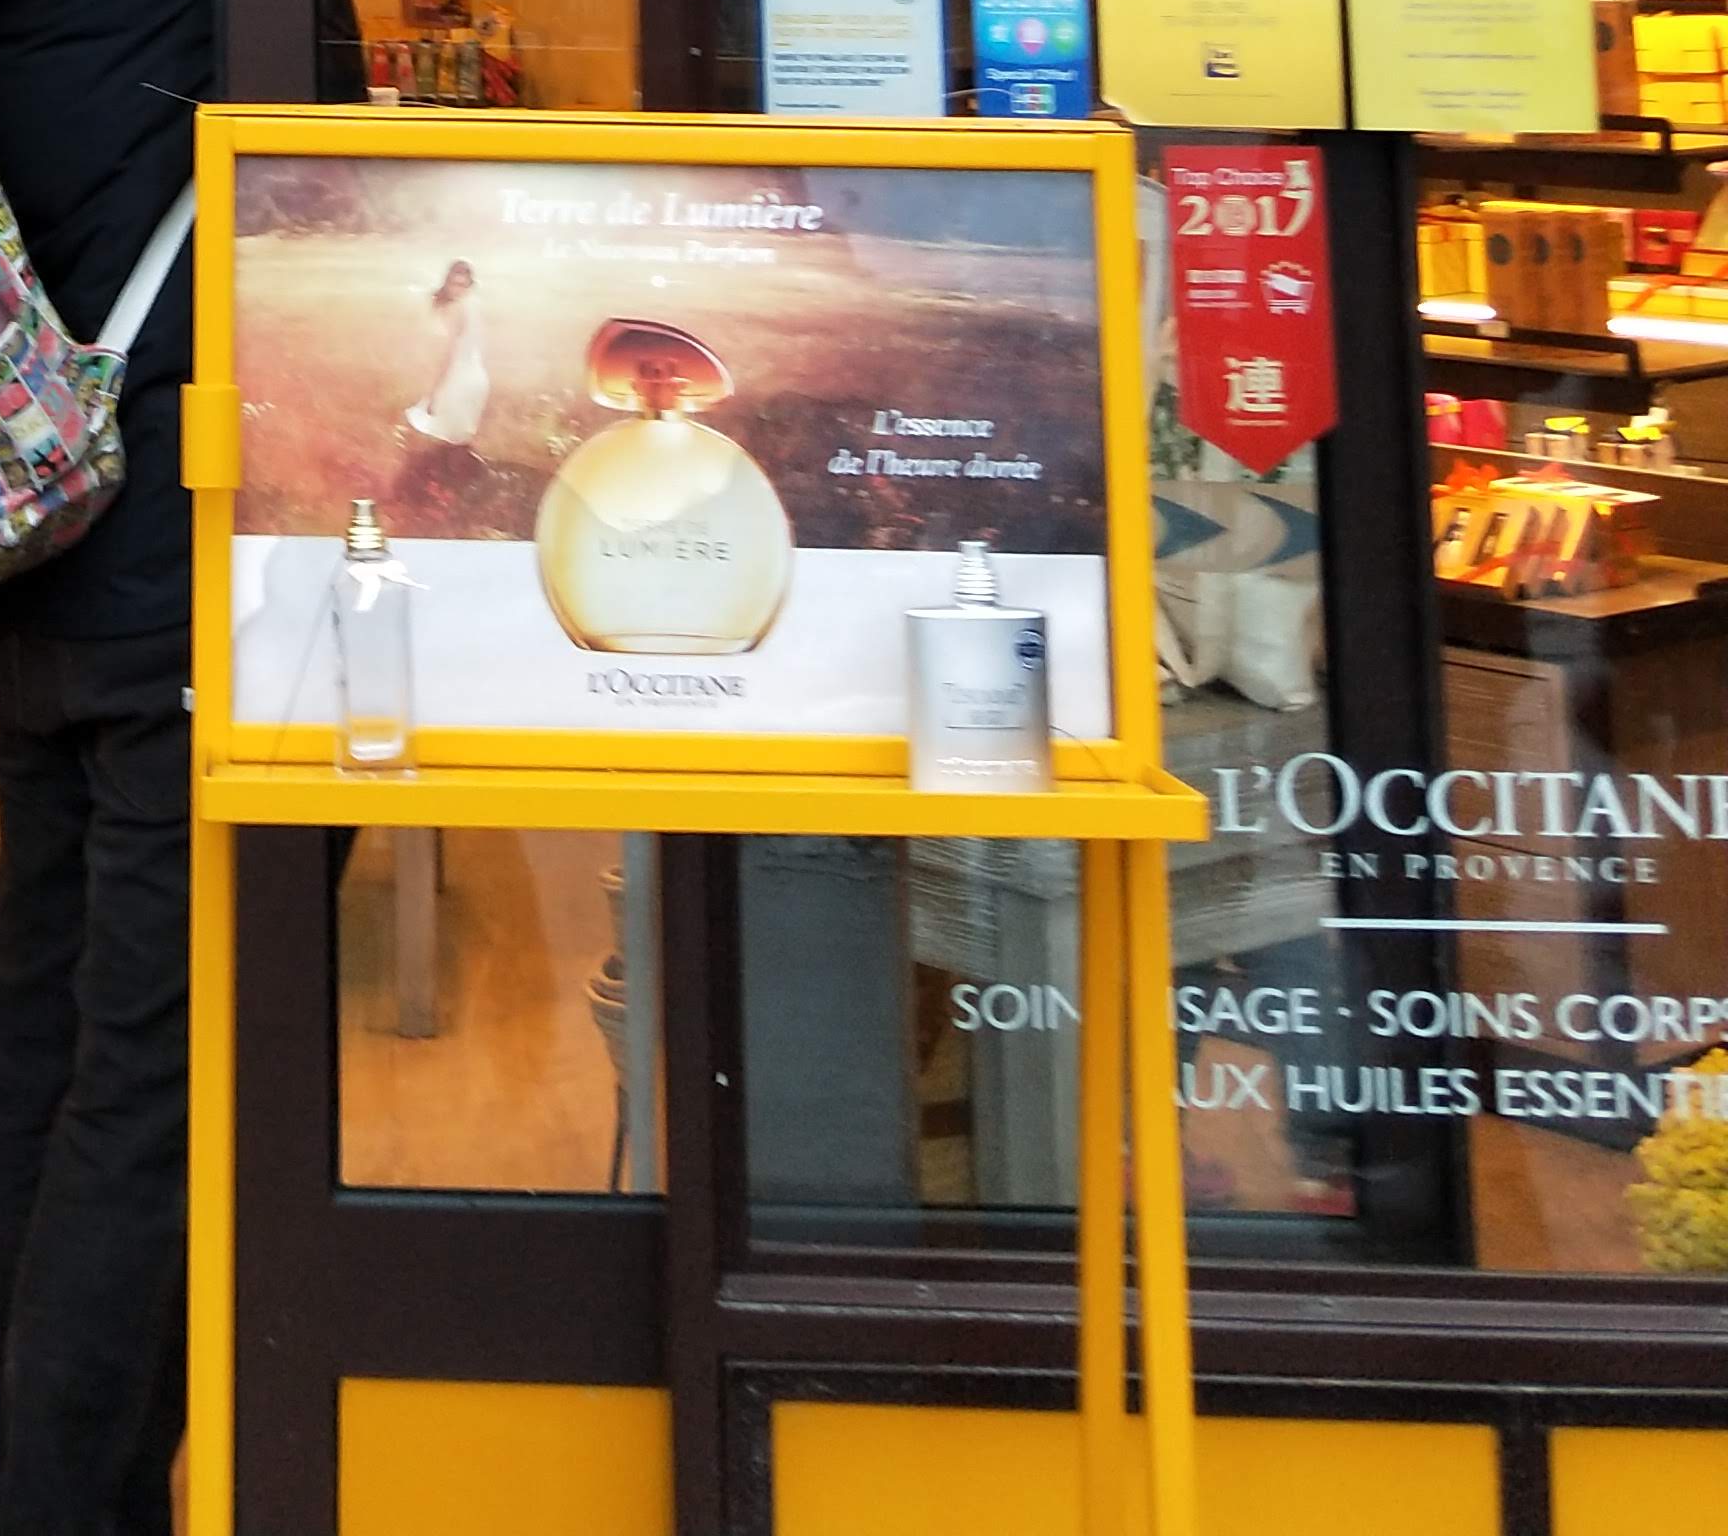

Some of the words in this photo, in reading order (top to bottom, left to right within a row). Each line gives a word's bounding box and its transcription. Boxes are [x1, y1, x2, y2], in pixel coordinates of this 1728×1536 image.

[605, 190, 653, 226] de
[660, 186, 825, 231] Lumière
[1177, 190, 1313, 237] 2017
[828, 448, 864, 476] de
[1319, 851, 1379, 880] EN
[1405, 851, 1662, 885] PROVENCE
[1367, 988, 1543, 1041] SOINS
[1286, 1064, 1482, 1116] HUILES
[1494, 1067, 1728, 1120] ESSENTI
